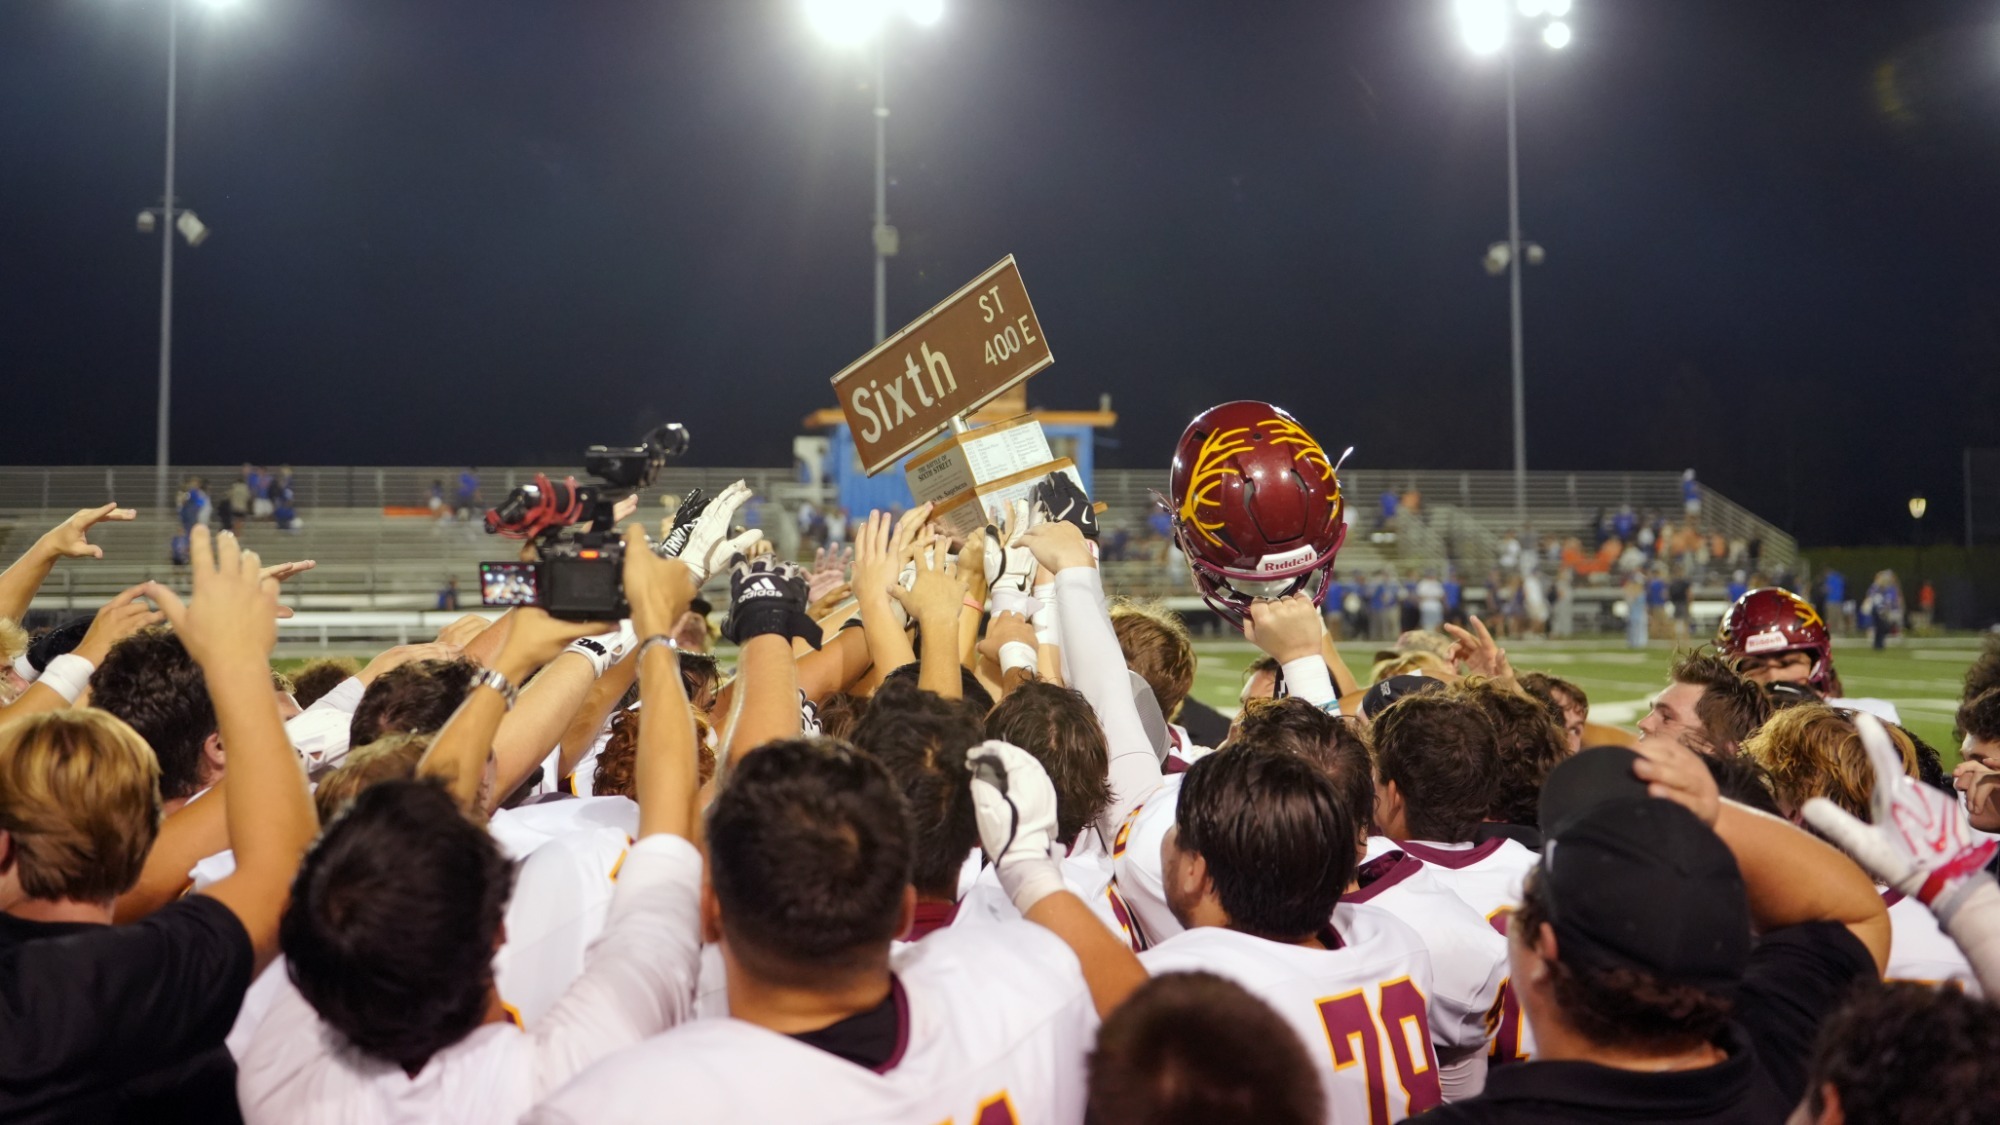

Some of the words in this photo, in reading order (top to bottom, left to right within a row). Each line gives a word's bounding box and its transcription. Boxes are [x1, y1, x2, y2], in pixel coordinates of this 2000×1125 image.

[979, 285, 1007, 324] ST
[984, 325, 1021, 366] 400
[1018, 315, 1036, 345] E
[851, 341, 957, 444] Sixth
[933, 459, 953, 474] STREET
[1264, 553, 1313, 571] Riddell
[737, 589, 783, 604] adidas
[1314, 974, 1443, 1125] 78
